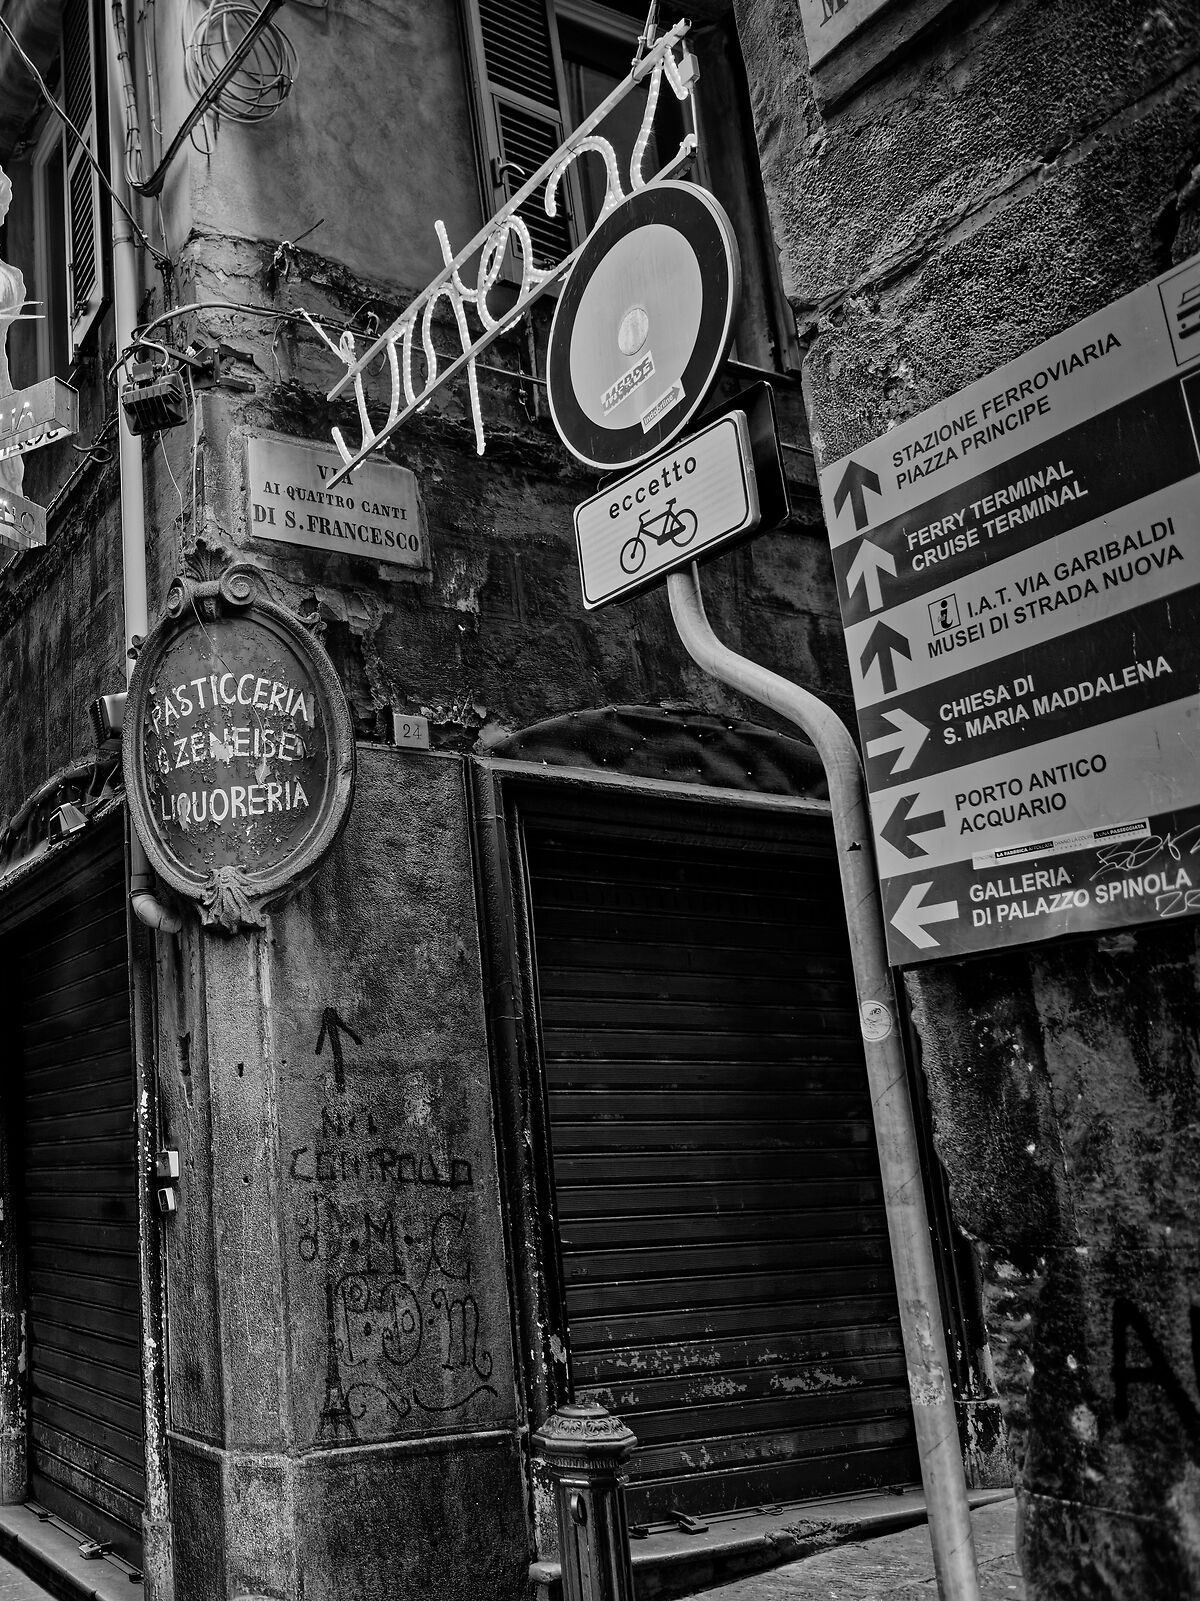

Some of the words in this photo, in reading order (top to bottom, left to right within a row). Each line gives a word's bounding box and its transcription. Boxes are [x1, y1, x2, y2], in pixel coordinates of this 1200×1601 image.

[892, 410, 978, 468] STAZIONE
[981, 332, 1122, 420] FERROVIARIA
[896, 447, 959, 490] PIAZZA
[960, 395, 1051, 456] PRINCIPE
[253, 503, 276, 525] DI
[263, 481, 280, 495] AI
[286, 485, 355, 510] QUATTRO
[361, 500, 407, 520] CANTI
[609, 456, 697, 519] eccetto
[907, 508, 966, 551] FERRY
[969, 461, 1074, 519] TERMINAL
[912, 528, 980, 572] CRUISE
[982, 480, 1089, 538] TERMINAL
[967, 587, 1012, 618] I.A.T.
[1015, 572, 1050, 597] VIA
[1054, 517, 1175, 581] GARIBALDI
[927, 622, 985, 659] MUSEI
[989, 613, 1009, 635] DI
[1014, 578, 1100, 624] STRADA
[1102, 545, 1184, 590] NUOVA
[151, 672, 308, 734] PASTICCERIA
[939, 684, 1012, 722] CHIESA
[1013, 675, 1035, 694] DI
[943, 727, 962, 745] S.
[965, 703, 1030, 738] MARIA
[1033, 655, 1173, 718] MADDALENA
[160, 780, 310, 824] LIQUORERIA
[954, 777, 1023, 811] PORTO
[1029, 754, 1108, 792] ANTICO
[959, 792, 1067, 835] ACQUARIO
[969, 866, 1072, 901] GALLERIA
[973, 907, 991, 927] DI
[997, 889, 1090, 923] PALAZZO
[1095, 868, 1192, 904] SPINOLA
